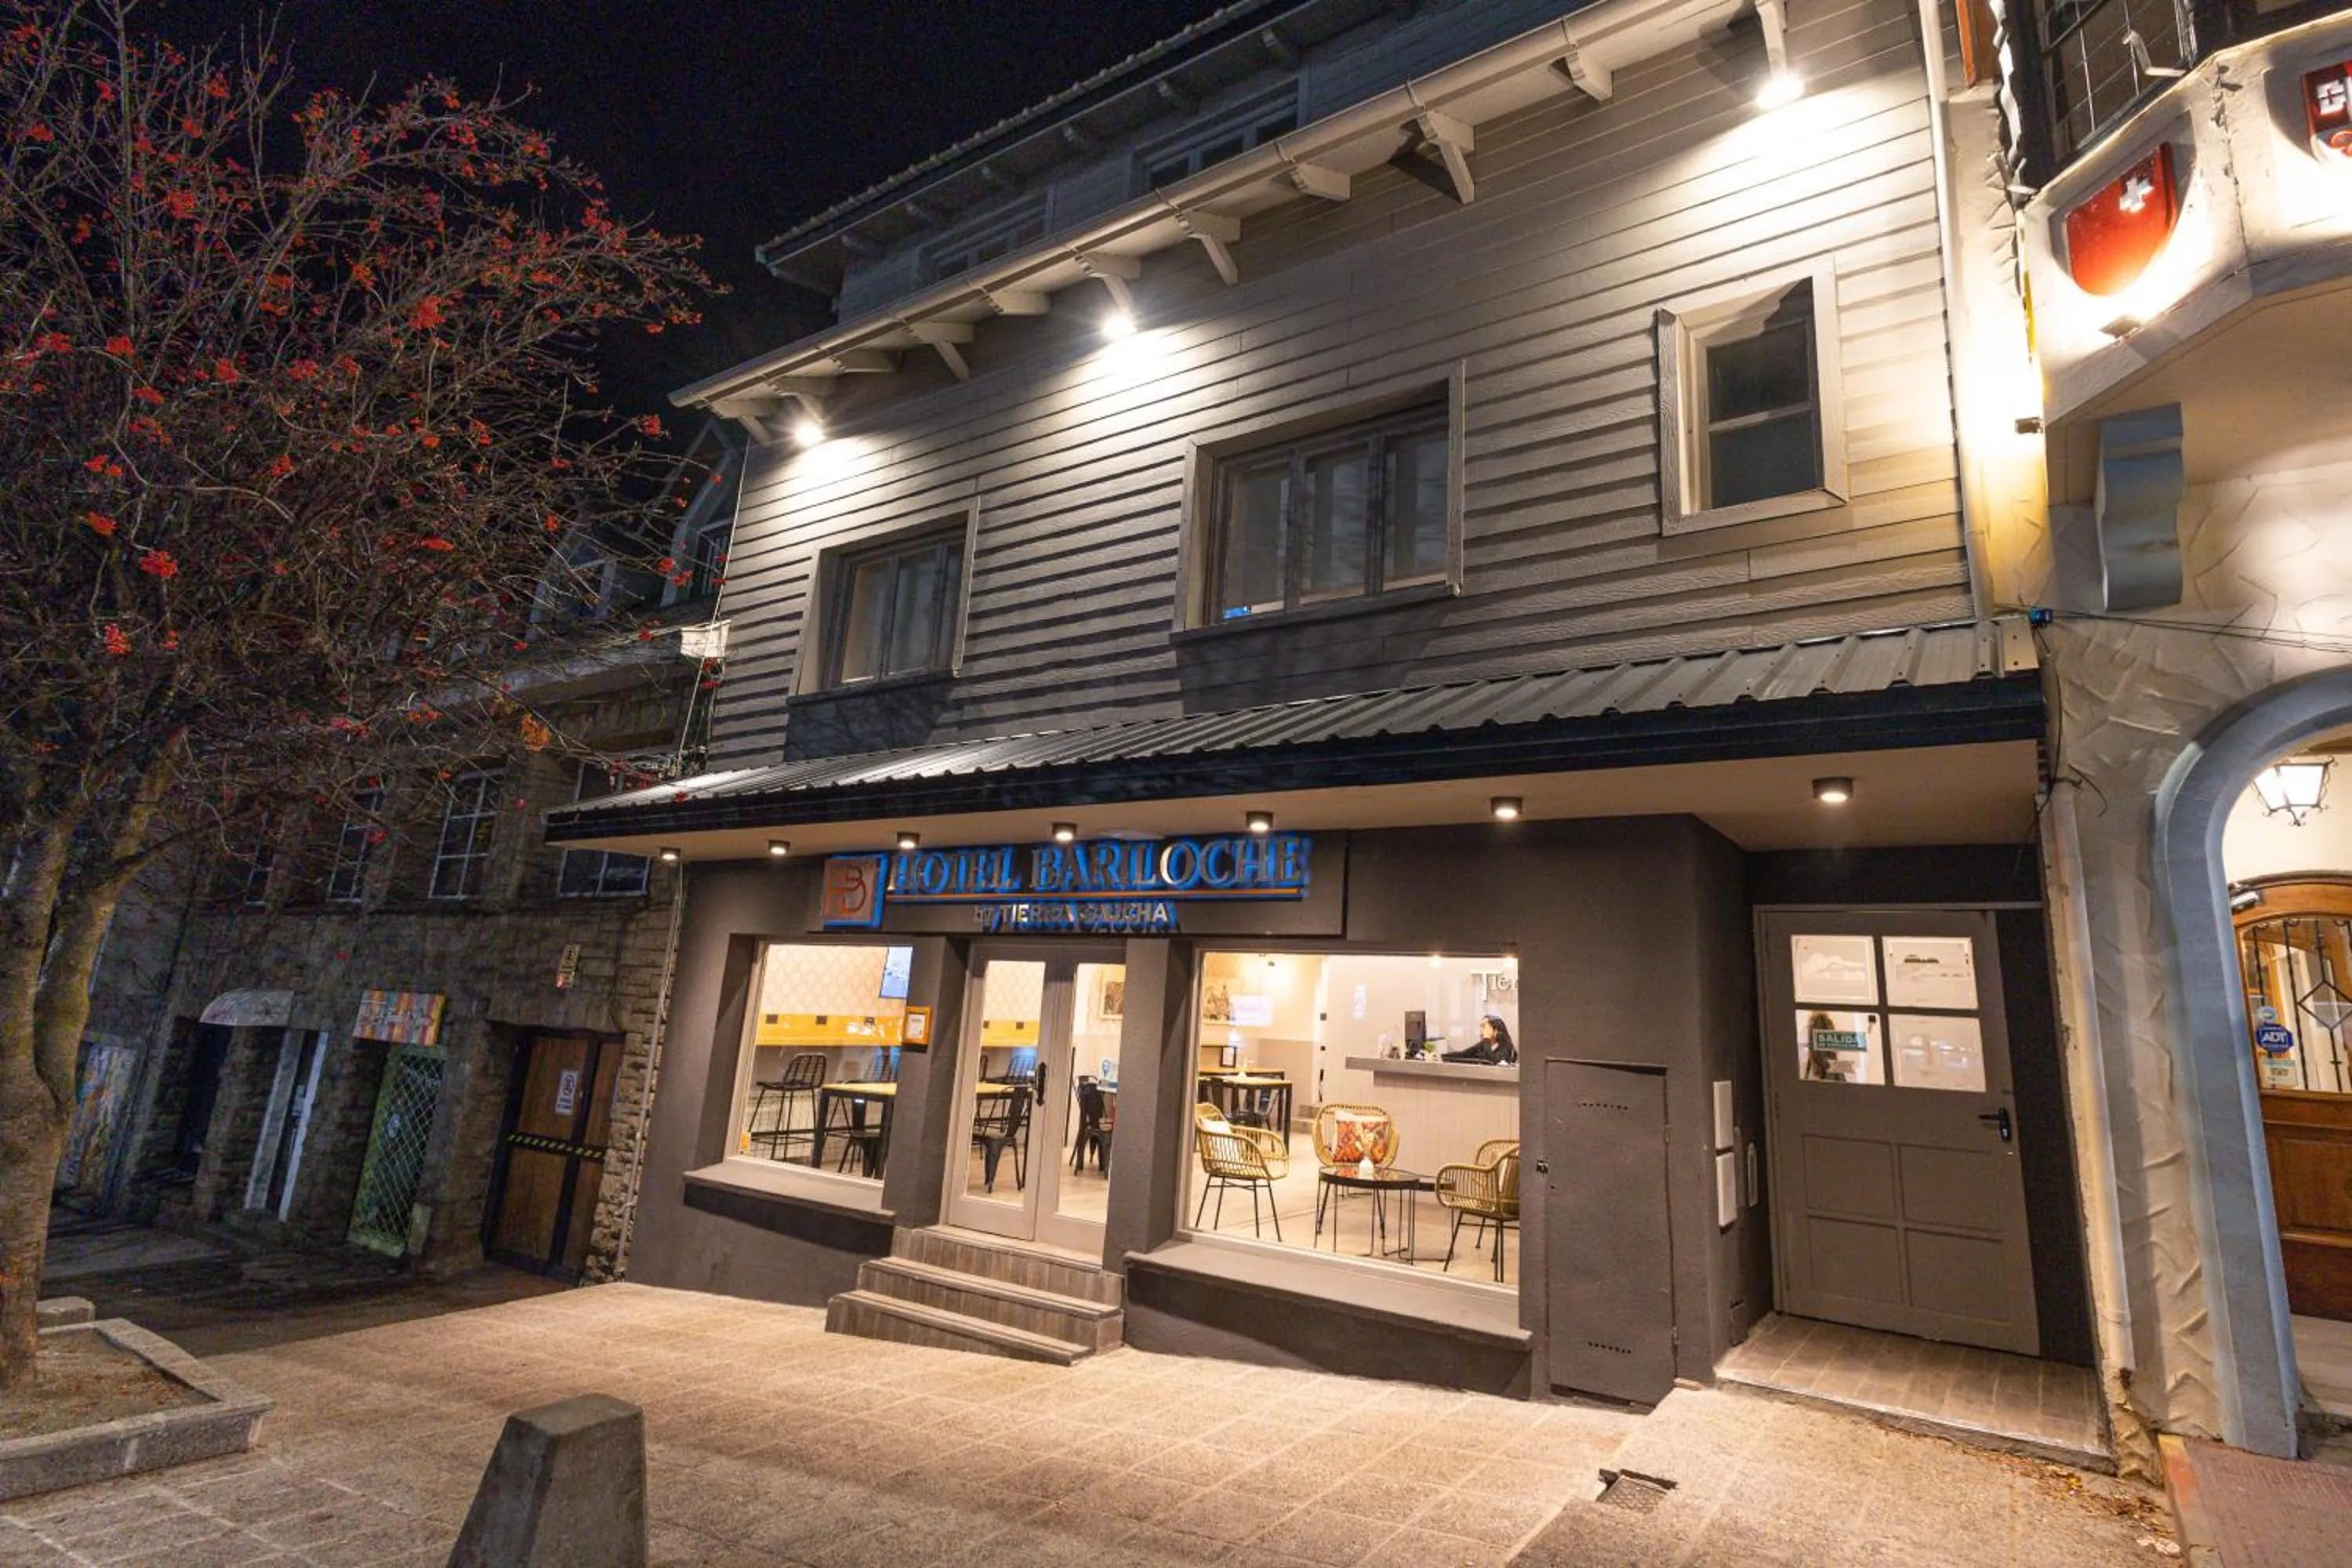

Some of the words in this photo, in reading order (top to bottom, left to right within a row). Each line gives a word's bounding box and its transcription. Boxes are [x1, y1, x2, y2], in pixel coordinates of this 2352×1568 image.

[887, 847, 1021, 894] HOTEL
[1029, 836, 1311, 891] BARILOCHE
[999, 904, 1075, 923] TIERRA
[2261, 1032, 2287, 1043] ADT
